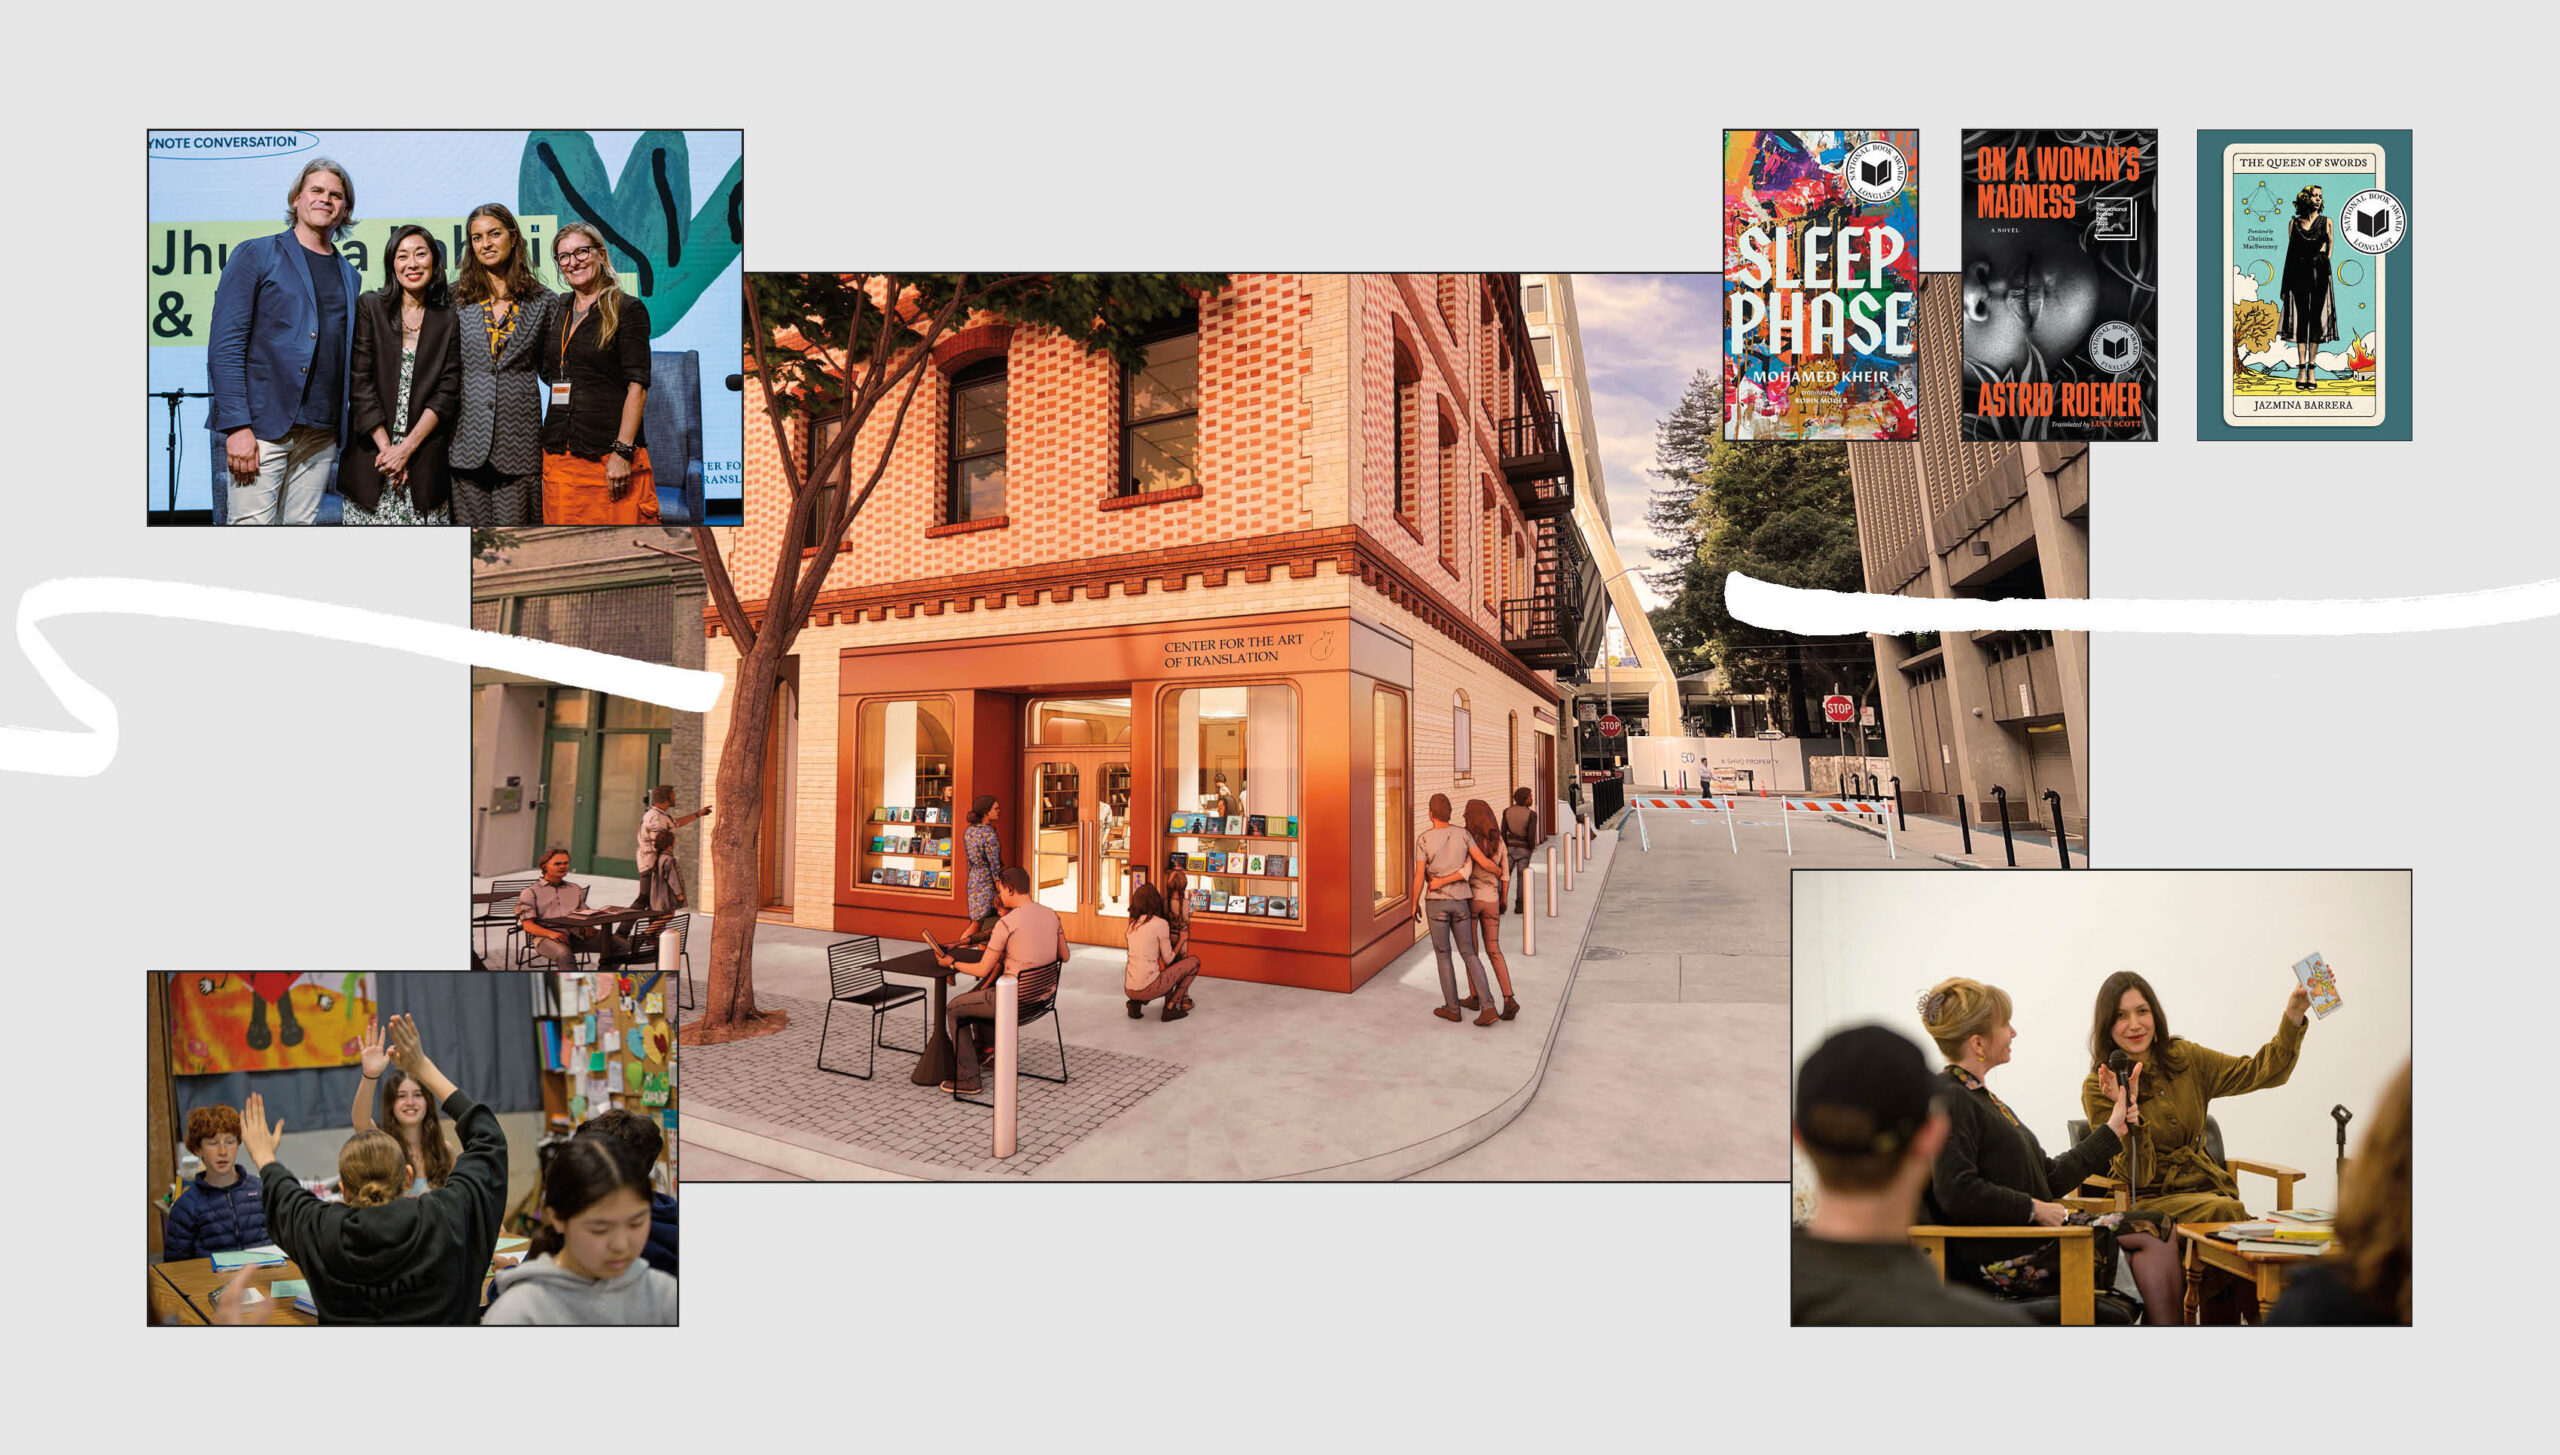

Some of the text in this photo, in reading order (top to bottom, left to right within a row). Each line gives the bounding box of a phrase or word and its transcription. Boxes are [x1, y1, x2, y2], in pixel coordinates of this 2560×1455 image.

[193, 136, 297, 148] CONVERSATION
[1849, 144, 1904, 181] NATIONAL BOOK AWARD
[1978, 146, 2140, 182] ON A WOMAN'S
[2239, 158, 2368, 169] THE QUEEN OF SWORDS
[1857, 186, 1896, 199] LONGLIST
[1978, 184, 2076, 219] MADNESS
[2344, 193, 2403, 232] NATIONAL BOOK AWARD
[2353, 237, 2394, 251] LONGLIST
[1737, 225, 1905, 289] SLEEP
[152, 290, 193, 338] &
[1729, 291, 1914, 355] PHASE
[2092, 324, 2139, 356] NATIONAL BOOK AWARD
[2100, 360, 2131, 370] FINALIST
[1753, 371, 1890, 383] MOHAMED KHEIR
[1978, 382, 2142, 417] ASTRID ROEMER
[2253, 401, 2353, 411] JAZMINA BARRERA
[2082, 421, 2090, 429] by
[1164, 634, 1304, 653] CENTER FOR THE ART
[1164, 651, 1279, 669] OF TRANSLATION
[1827, 703, 1852, 714] STOP
[1600, 721, 1620, 731] STOP
